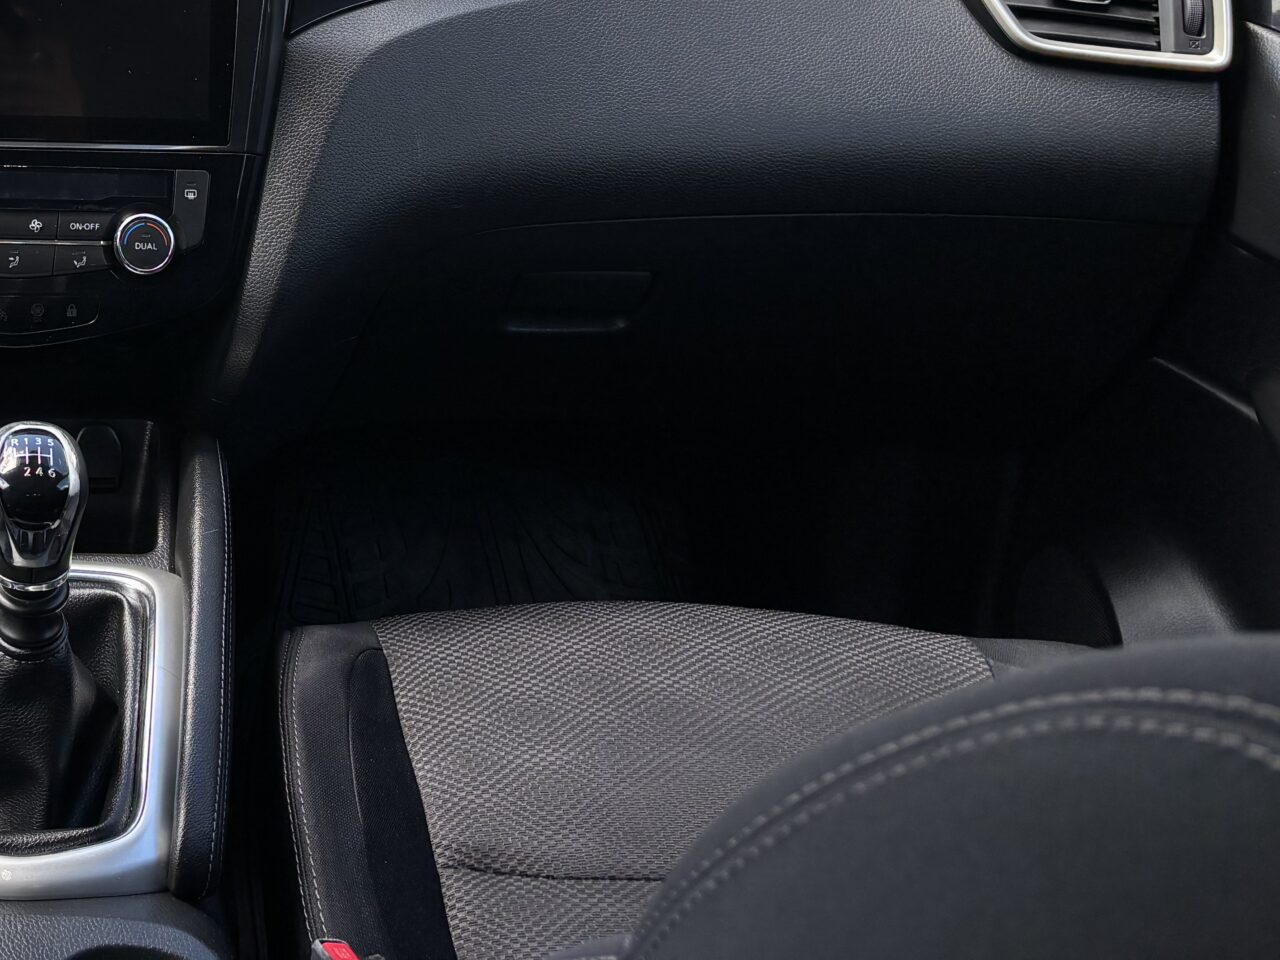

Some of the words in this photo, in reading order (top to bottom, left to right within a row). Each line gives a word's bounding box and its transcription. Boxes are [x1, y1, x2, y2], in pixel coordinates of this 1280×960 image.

[135, 242, 158, 251] DUAL
[11, 438, 19, 446] R
[35, 437, 41, 445] 3
[23, 466, 31, 477] 2
[35, 467, 43, 477] 4
[48, 468, 56, 478] 6
